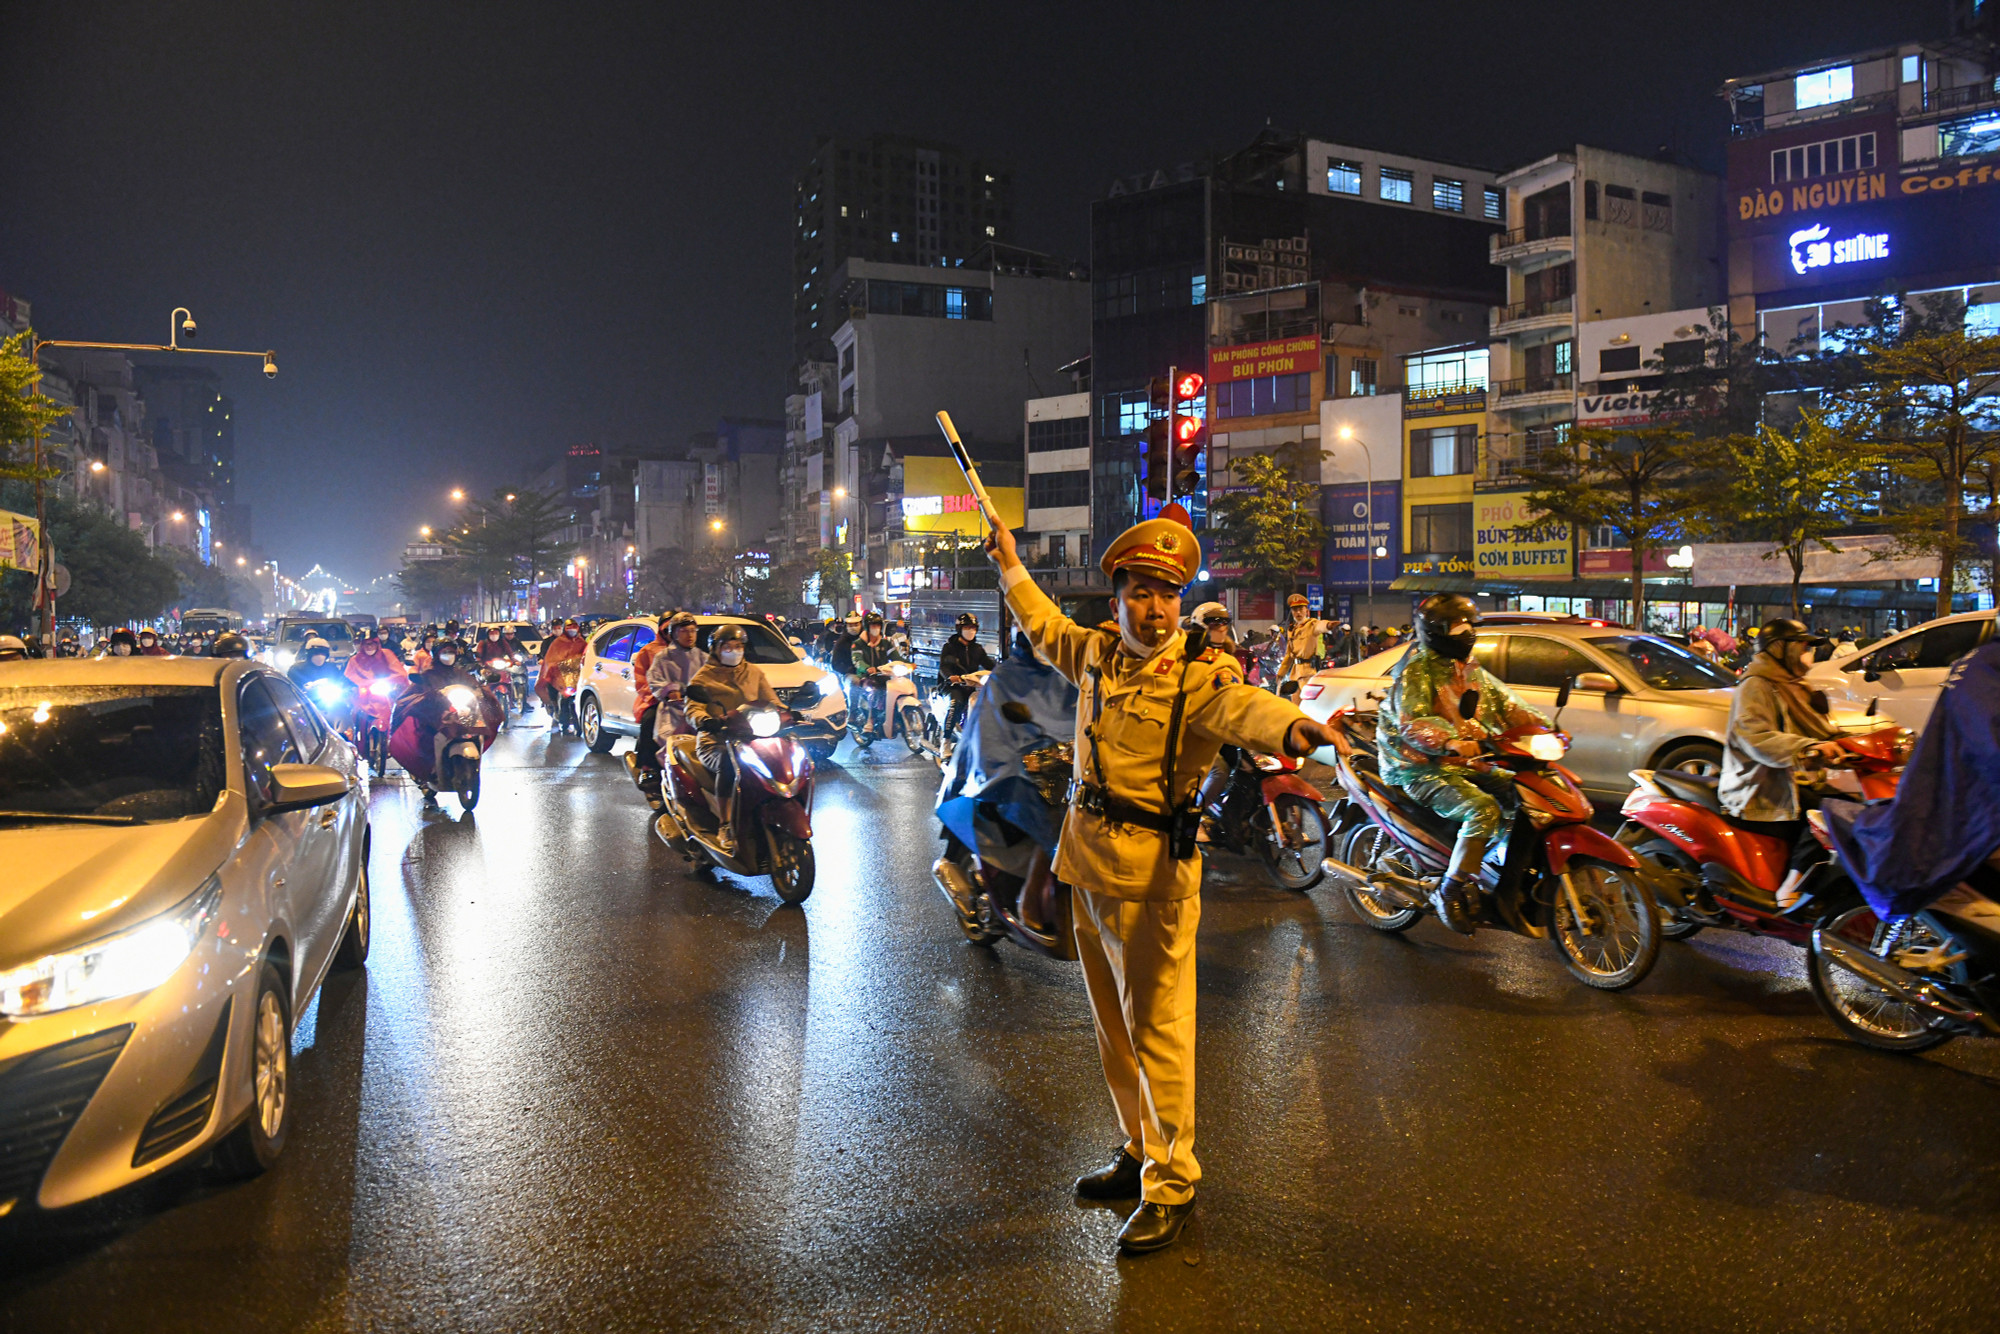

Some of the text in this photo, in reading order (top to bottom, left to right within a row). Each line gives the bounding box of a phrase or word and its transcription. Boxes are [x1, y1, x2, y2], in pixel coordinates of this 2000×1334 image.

[1739, 171, 1886, 220] ĐÀO NGUYÊN
[1231, 347, 1259, 361] PHÒNG
[1261, 343, 1284, 357] CÔNG
[1233, 361, 1254, 377] BÙI
[1334, 534, 1365, 548] TOÀN
[1477, 525, 1508, 545] BÚN
[1512, 549, 1567, 566] BUFFET
